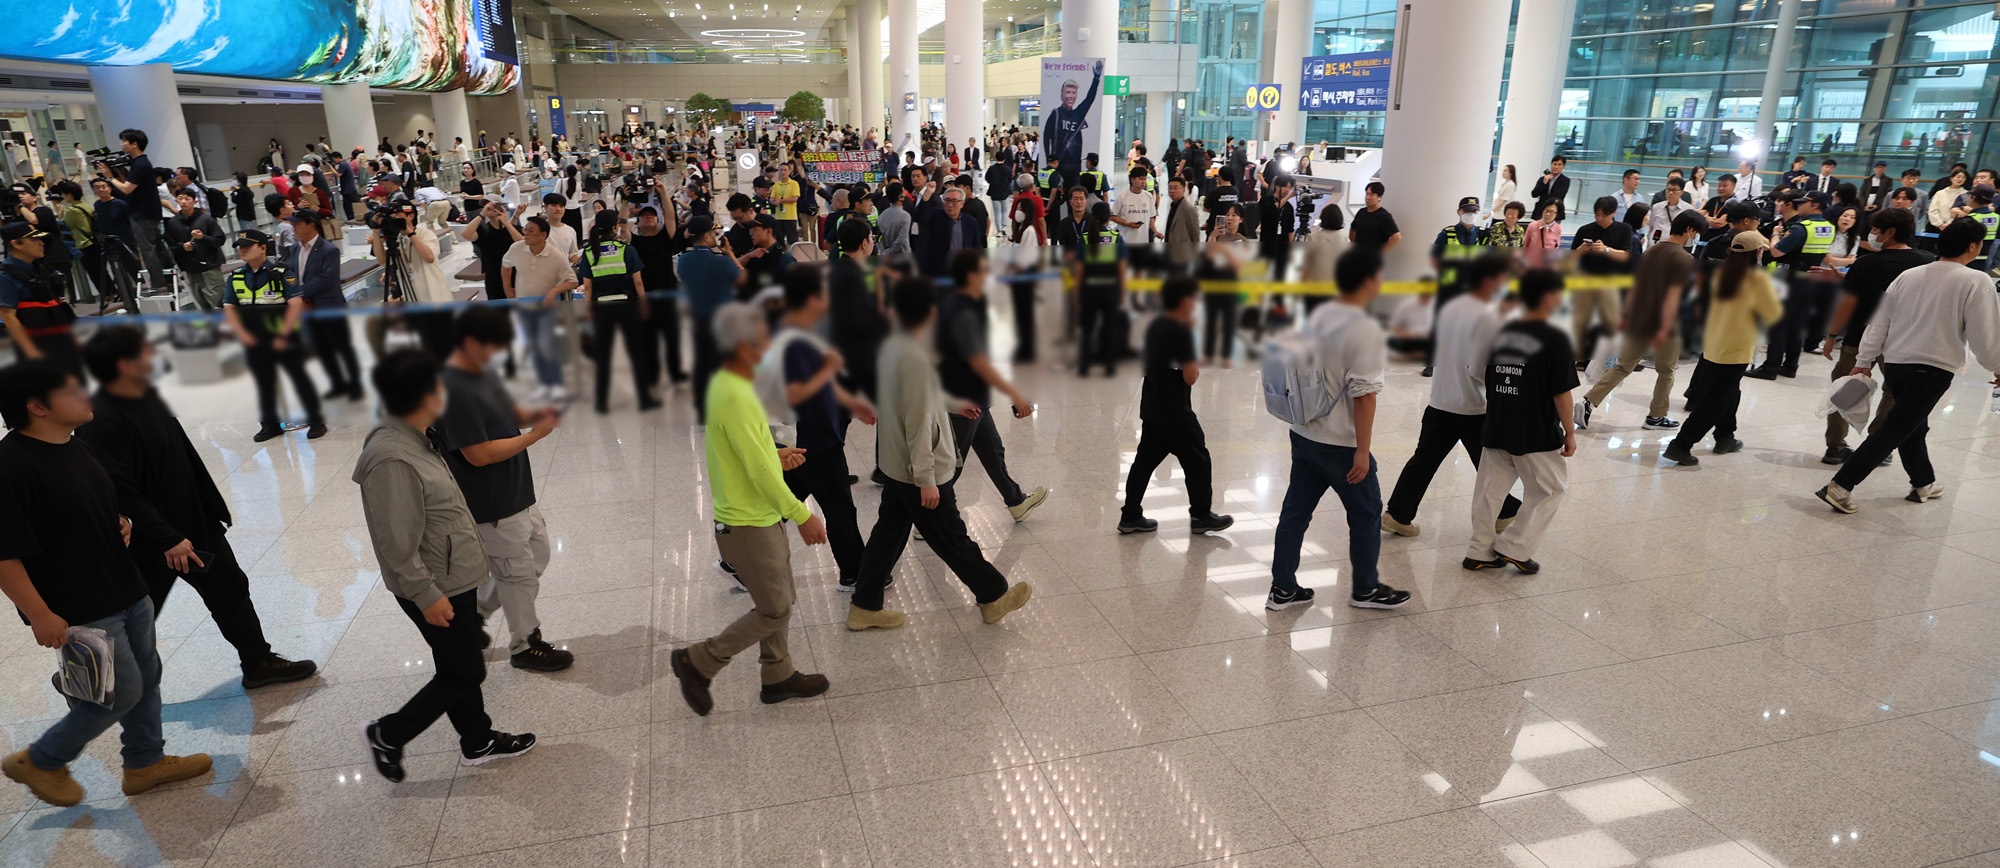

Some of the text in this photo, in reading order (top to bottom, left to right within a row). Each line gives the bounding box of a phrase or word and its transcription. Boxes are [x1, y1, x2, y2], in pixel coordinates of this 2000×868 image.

[1044, 62, 1061, 71] We're
[551, 98, 560, 109] B
[1367, 97, 1387, 107] Parking
[1062, 119, 1077, 131] ICE
[1495, 365, 1523, 376] OLDMOON
[1505, 376, 1511, 384] &
